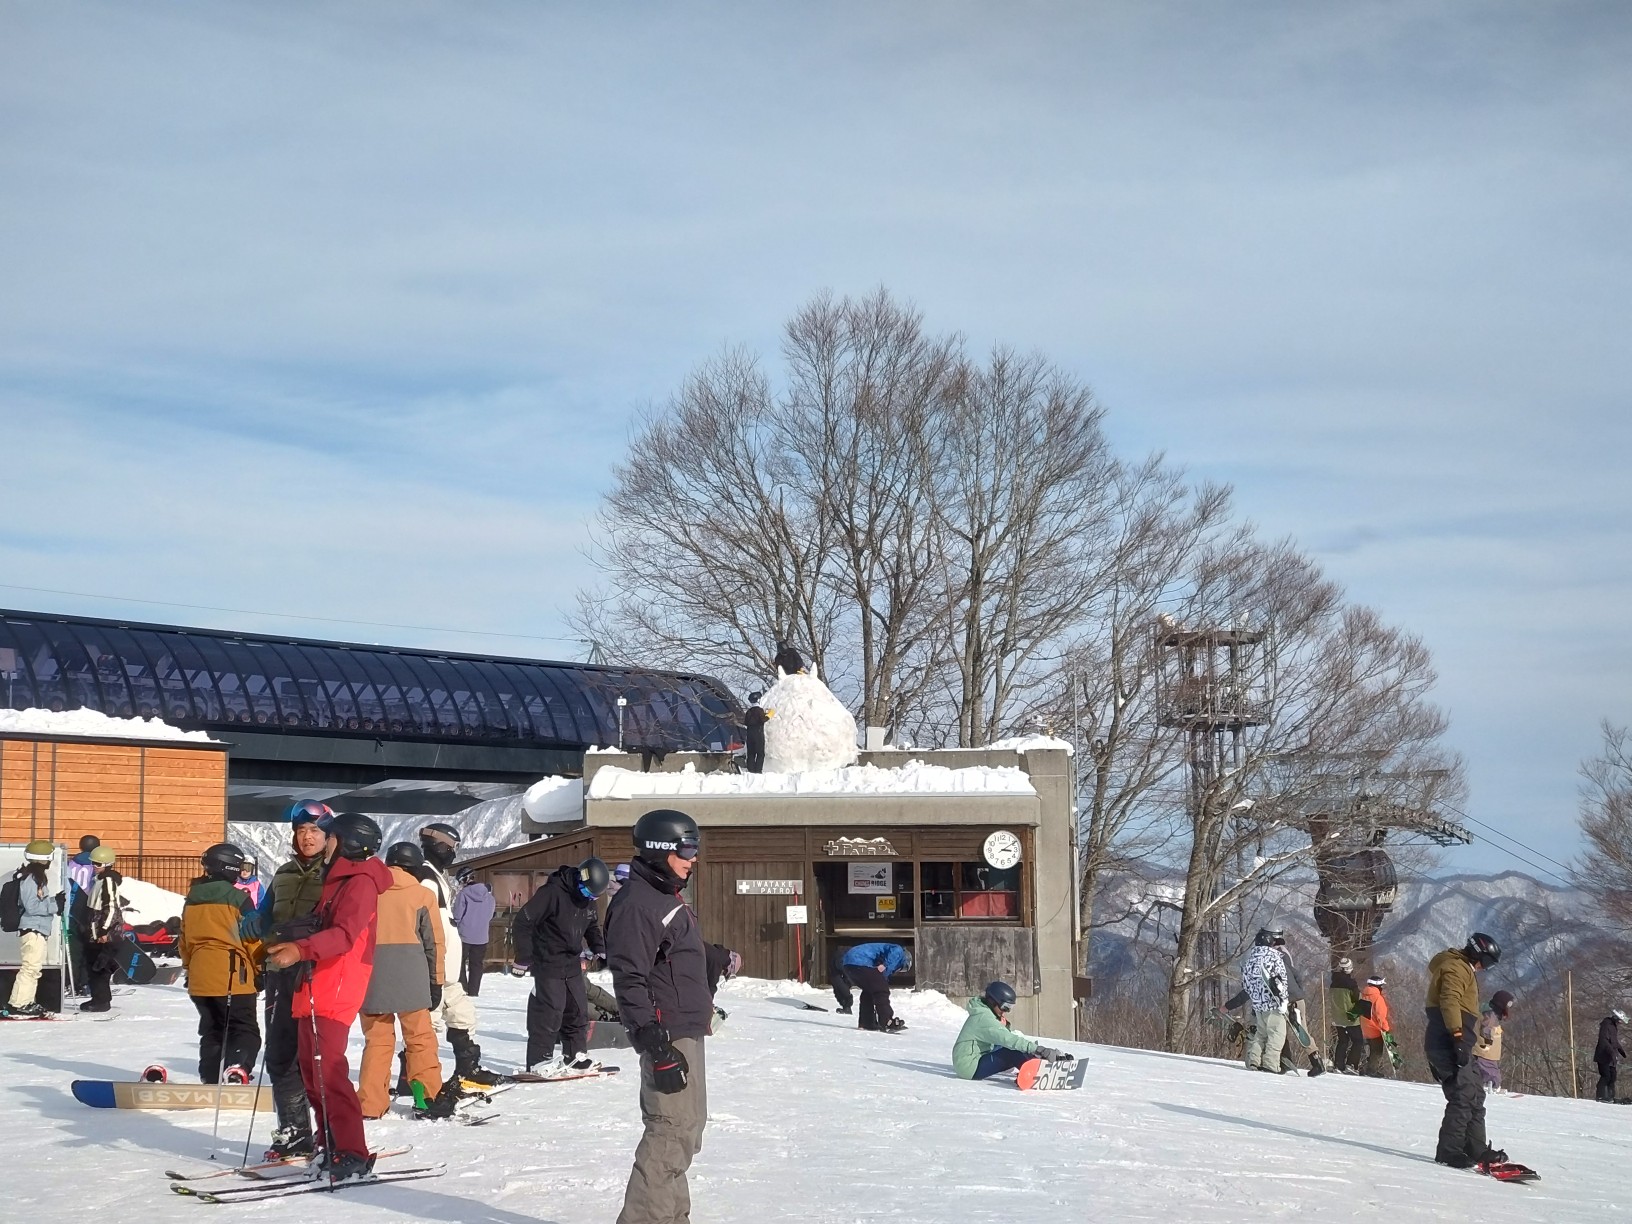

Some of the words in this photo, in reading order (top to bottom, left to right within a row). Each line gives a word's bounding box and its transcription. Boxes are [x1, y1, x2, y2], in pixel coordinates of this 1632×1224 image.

[645, 840, 678, 851] uvex
[71, 866, 89, 890] 10
[752, 880, 793, 888] IWATAKE
[138, 1089, 250, 1105] ZUMASB
